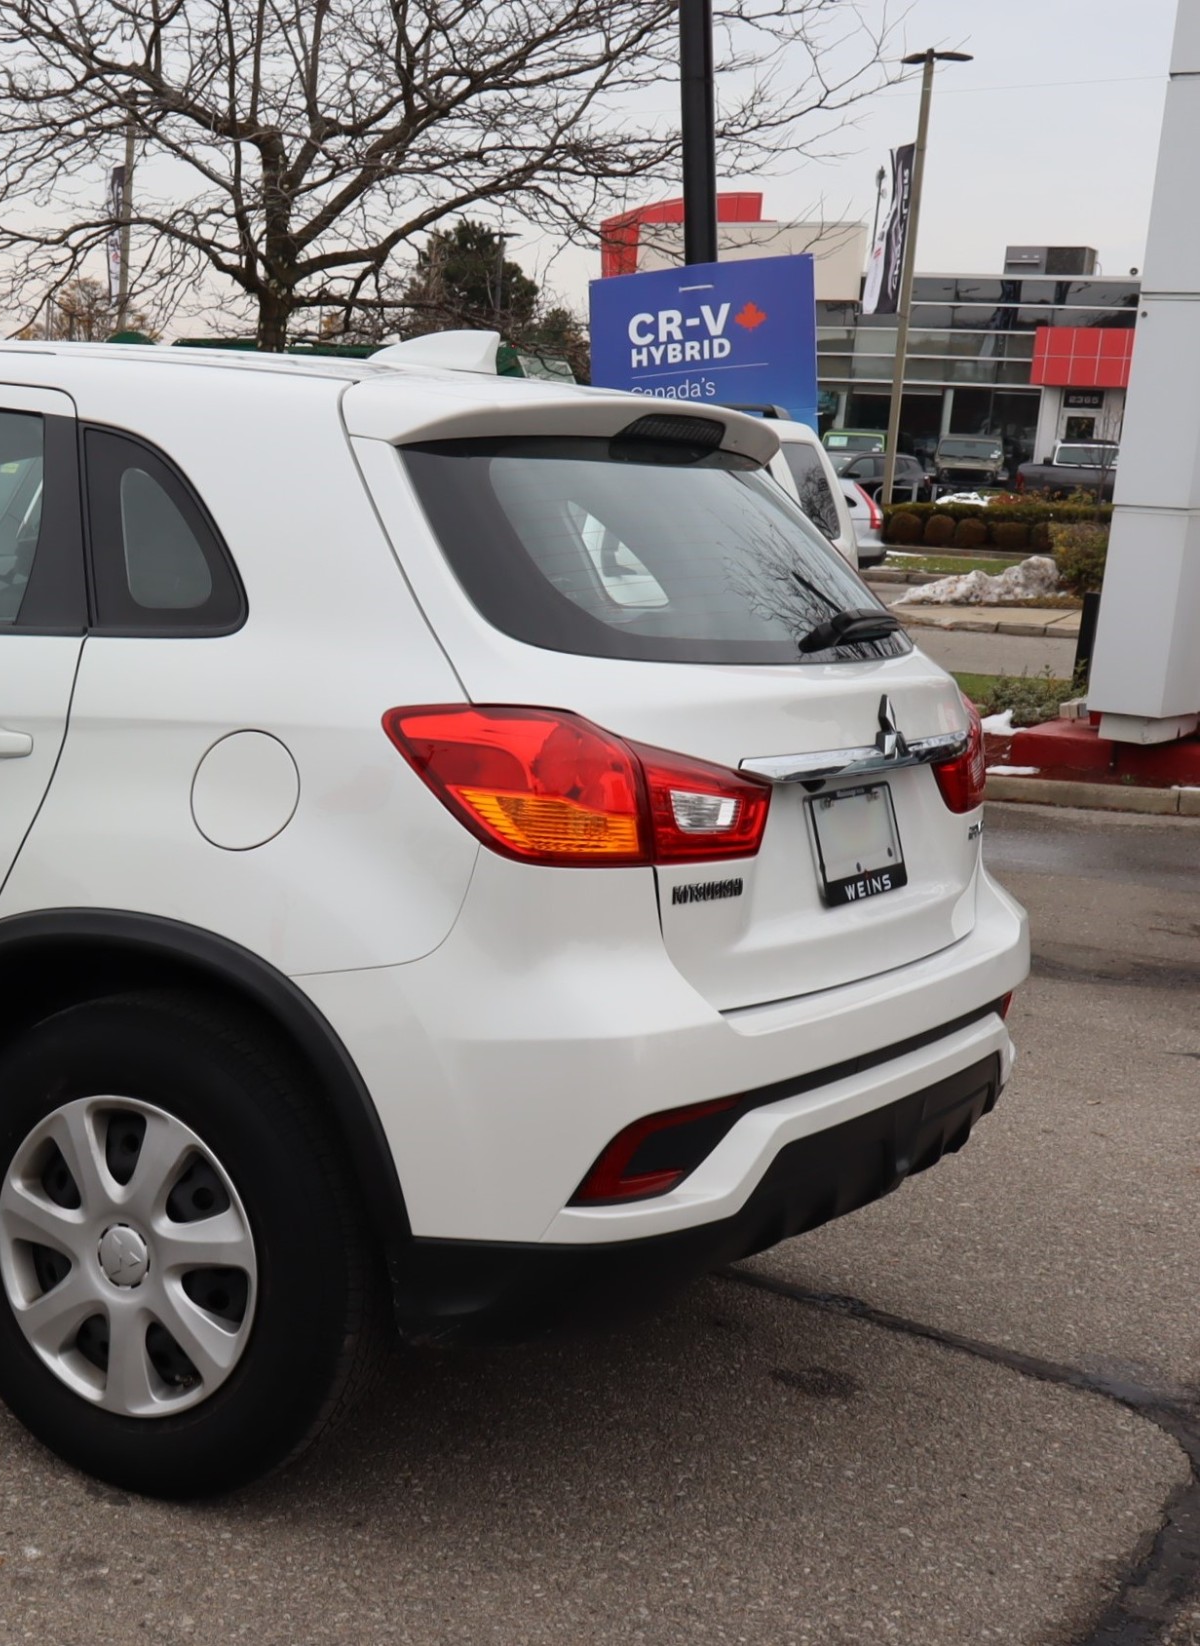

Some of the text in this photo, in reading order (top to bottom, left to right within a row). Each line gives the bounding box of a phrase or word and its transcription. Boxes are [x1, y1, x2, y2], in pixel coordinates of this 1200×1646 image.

[628, 302, 731, 346] CR-V
[631, 338, 732, 368] HYBRID
[844, 873, 892, 901] WEINS
